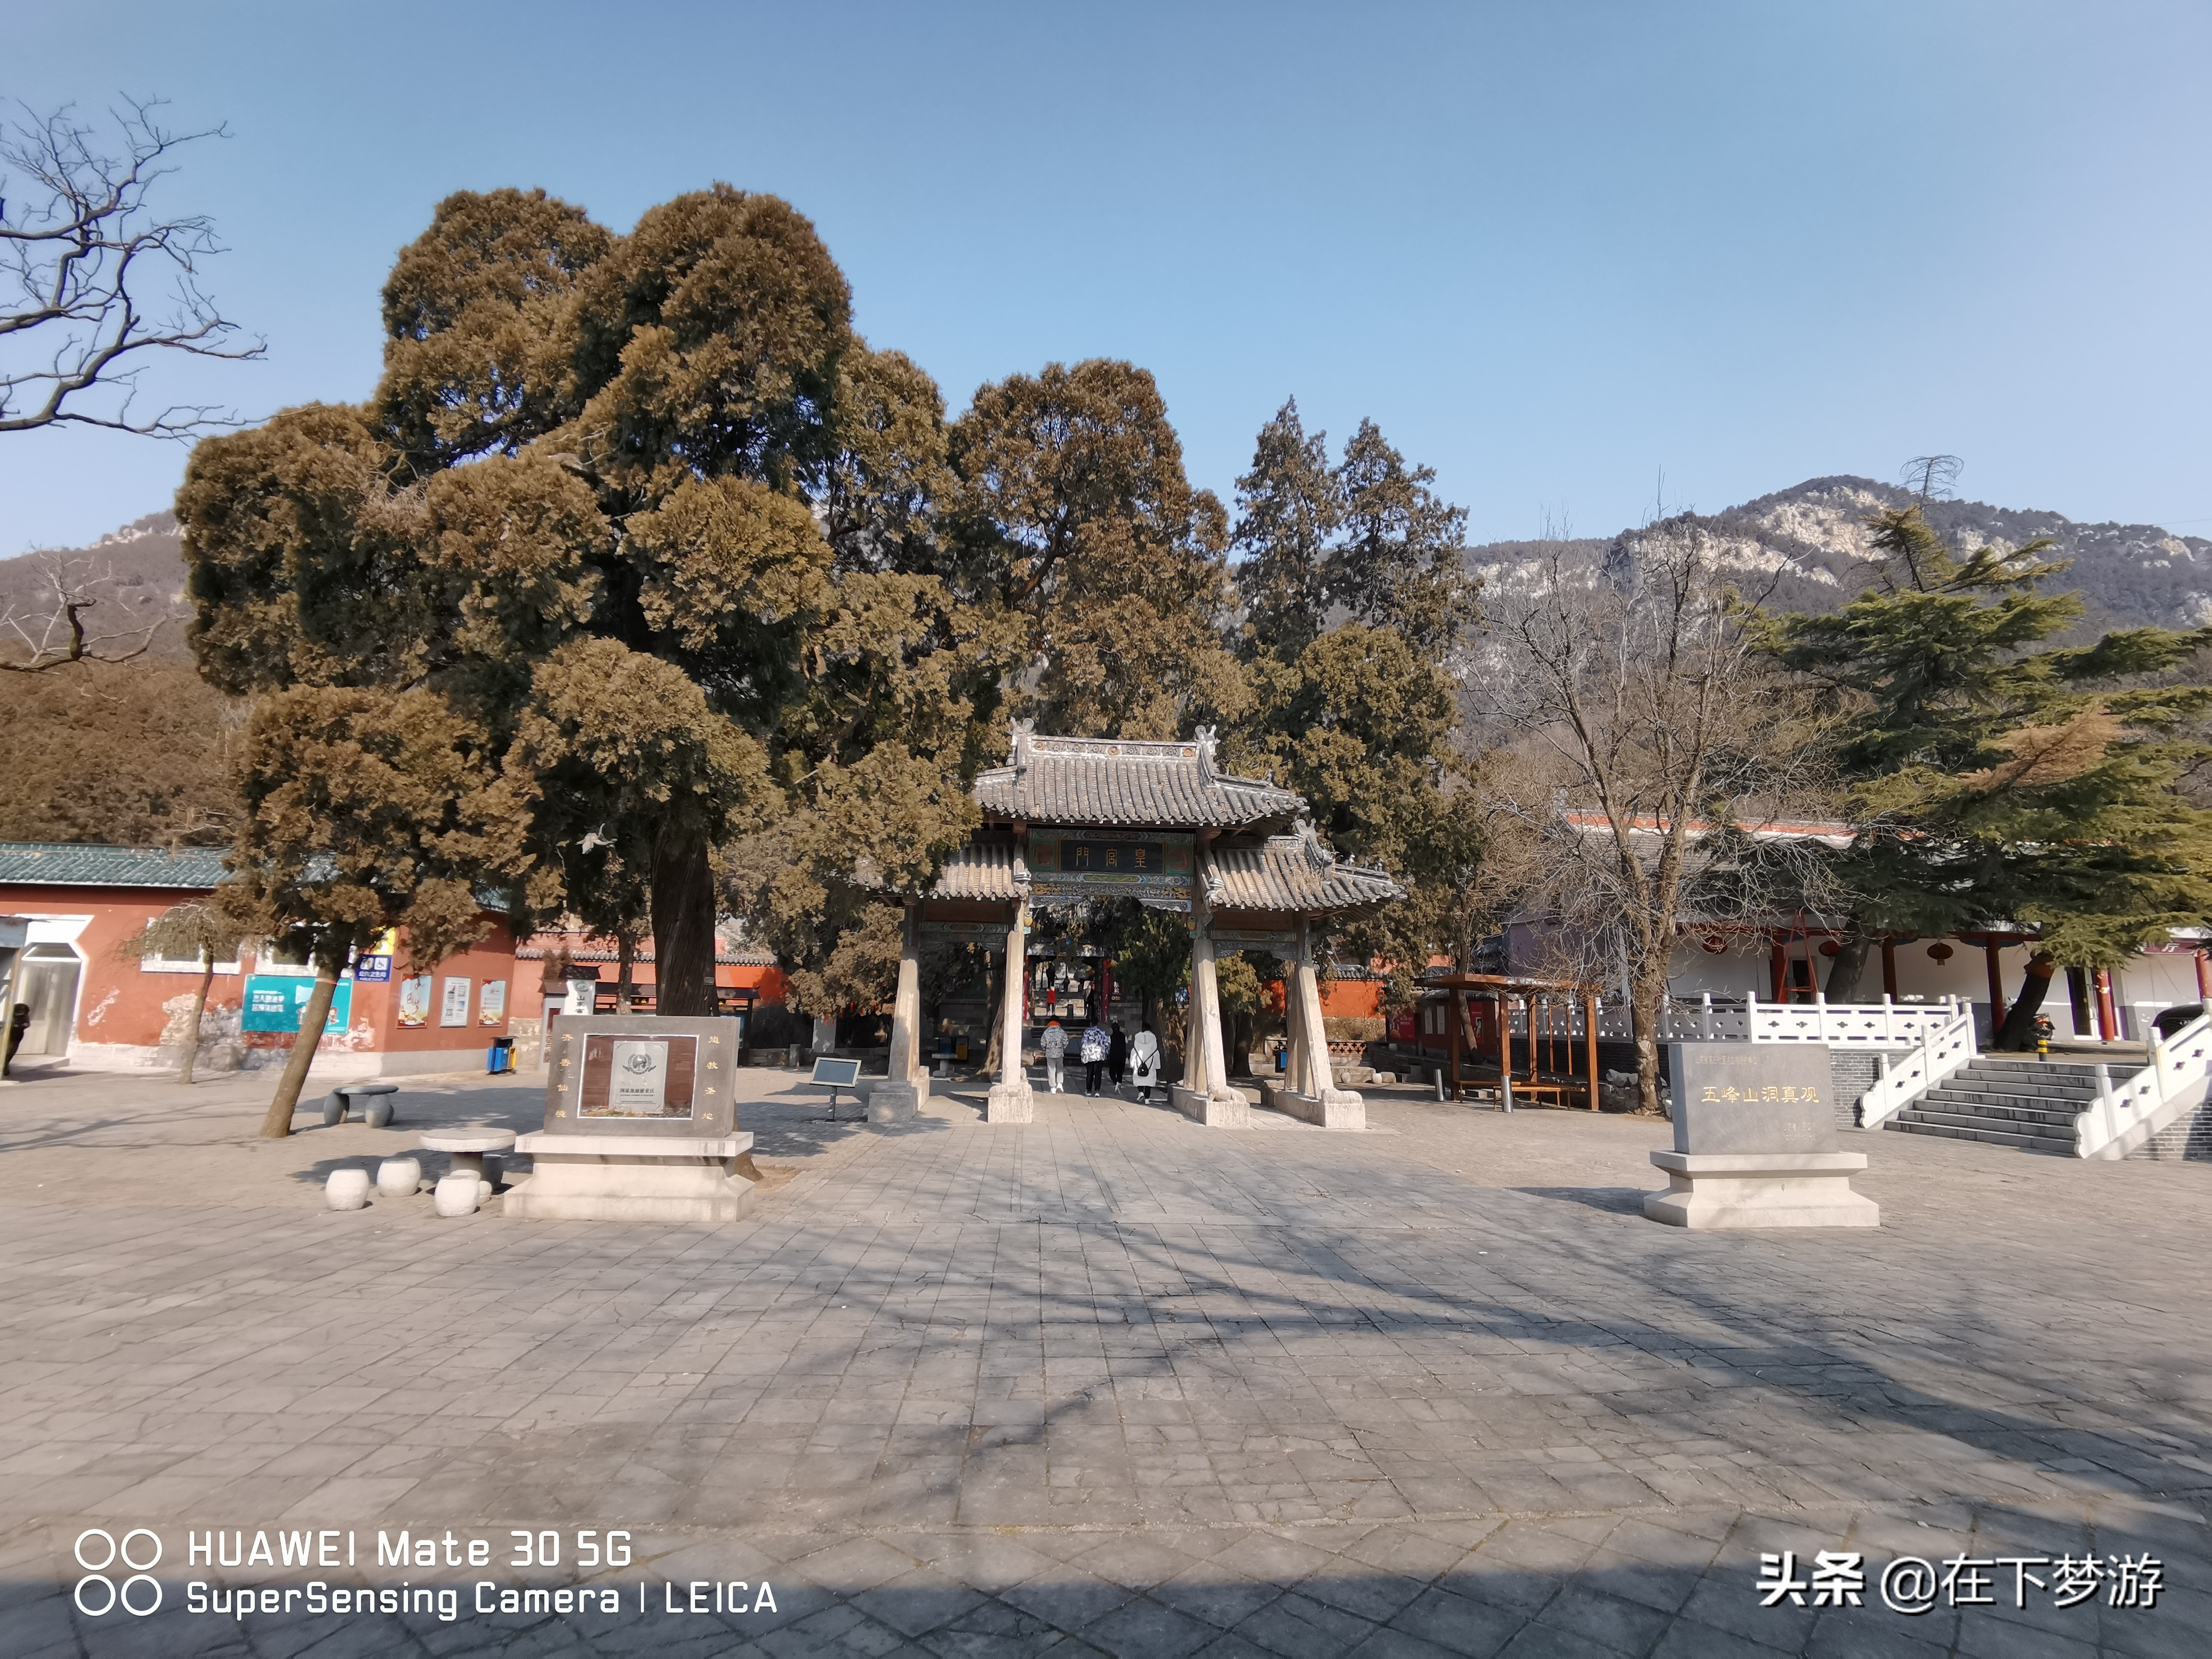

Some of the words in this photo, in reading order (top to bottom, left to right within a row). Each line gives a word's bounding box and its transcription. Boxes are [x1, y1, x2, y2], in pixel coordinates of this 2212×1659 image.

[701, 1036, 720, 1120] 道教圣地
[1701, 1086, 1819, 1103] 五峰山洞真观
